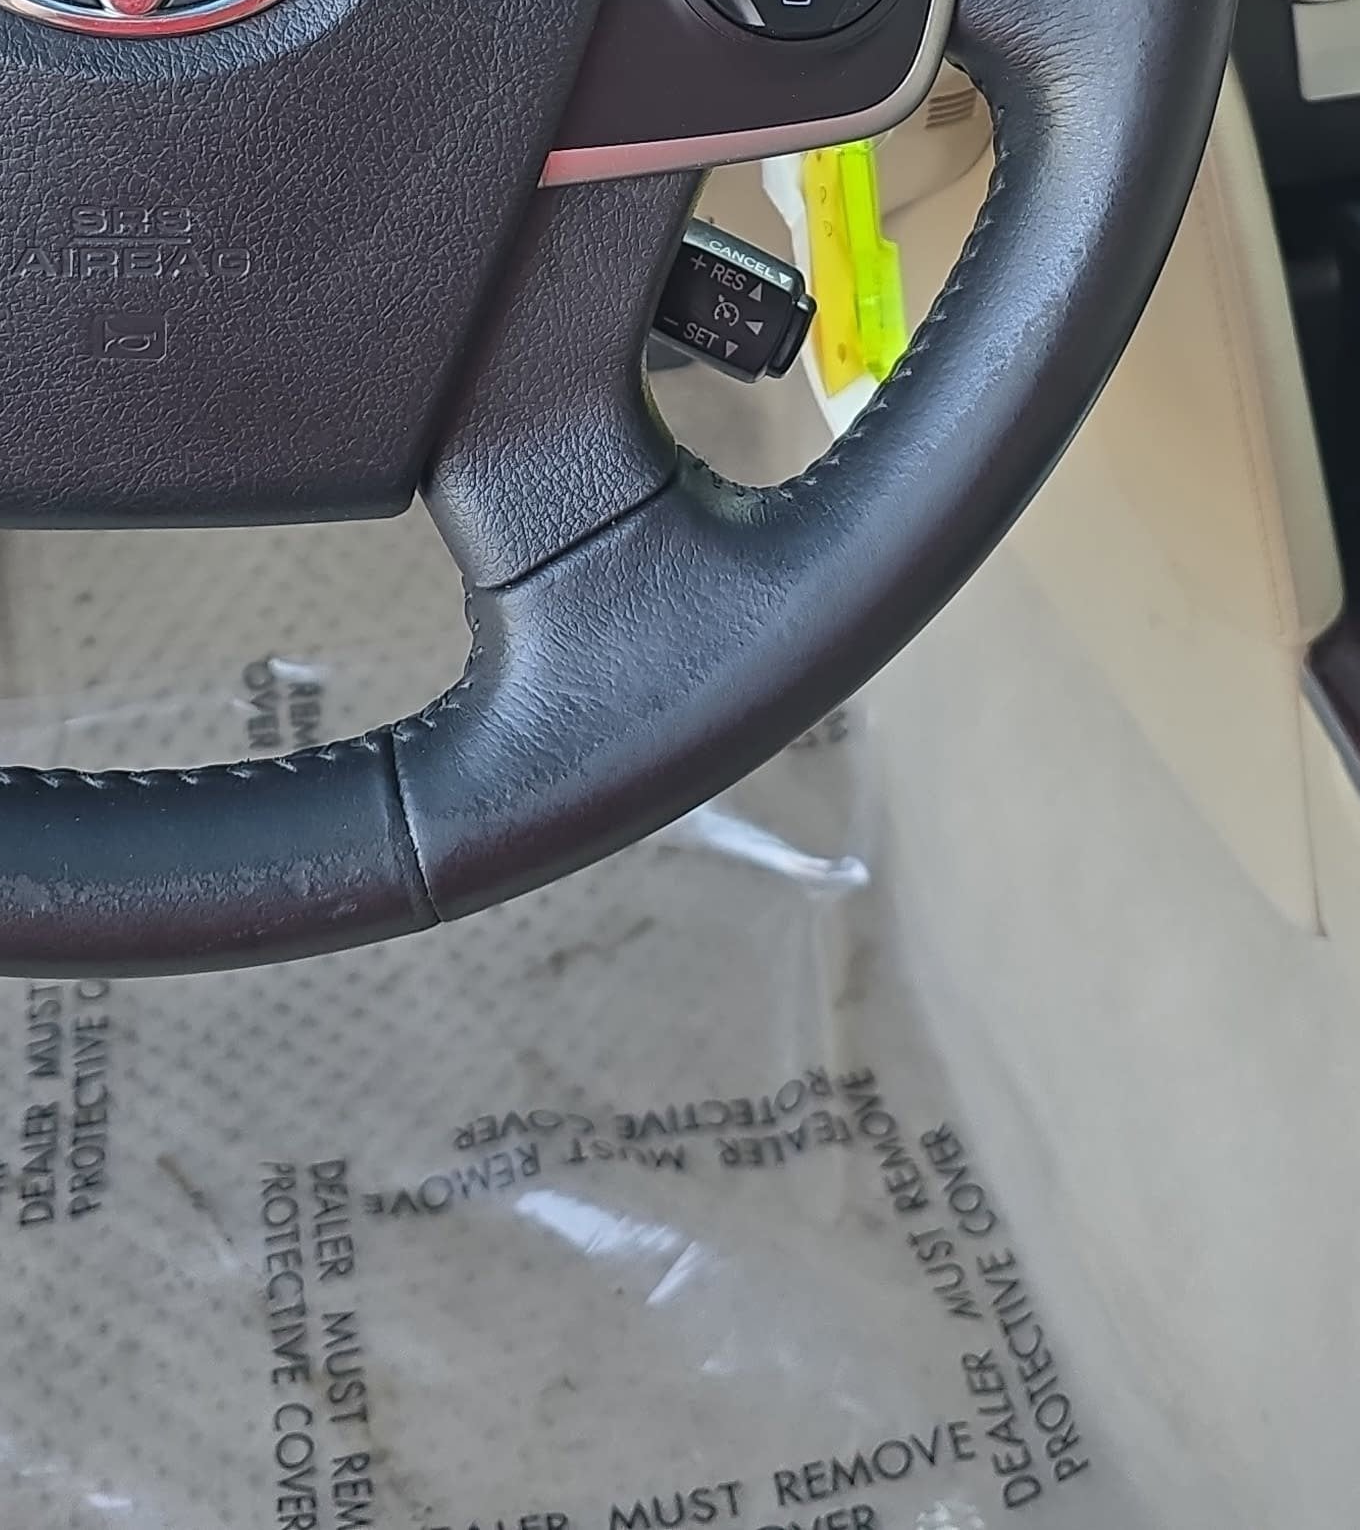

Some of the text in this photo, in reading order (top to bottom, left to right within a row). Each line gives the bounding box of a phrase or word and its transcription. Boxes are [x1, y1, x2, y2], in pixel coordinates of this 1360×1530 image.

[15, 246, 251, 280] AIRBAG
[70, 205, 192, 236] SRS
[709, 239, 775, 281] CANCEL
[710, 261, 748, 292] RES
[682, 321, 719, 350] SET
[18, 982, 63, 1230] DEALER MUST
[64, 1015, 112, 1221] PROTECTIVE
[454, 1067, 833, 1151] ROTECTIVE COVER
[568, 1136, 686, 1173] MUST
[307, 1159, 356, 1281] DEALER
[363, 1143, 540, 1216] REMOVE
[258, 1160, 311, 1386] PROTECTIVE
[840, 1066, 1042, 1509] DEALER MUST REMOVE
[920, 1122, 1091, 1482] PROTECTIVE COVER
[321, 1310, 369, 1425] MUST
[609, 1419, 977, 1530] MUST REMOVE
